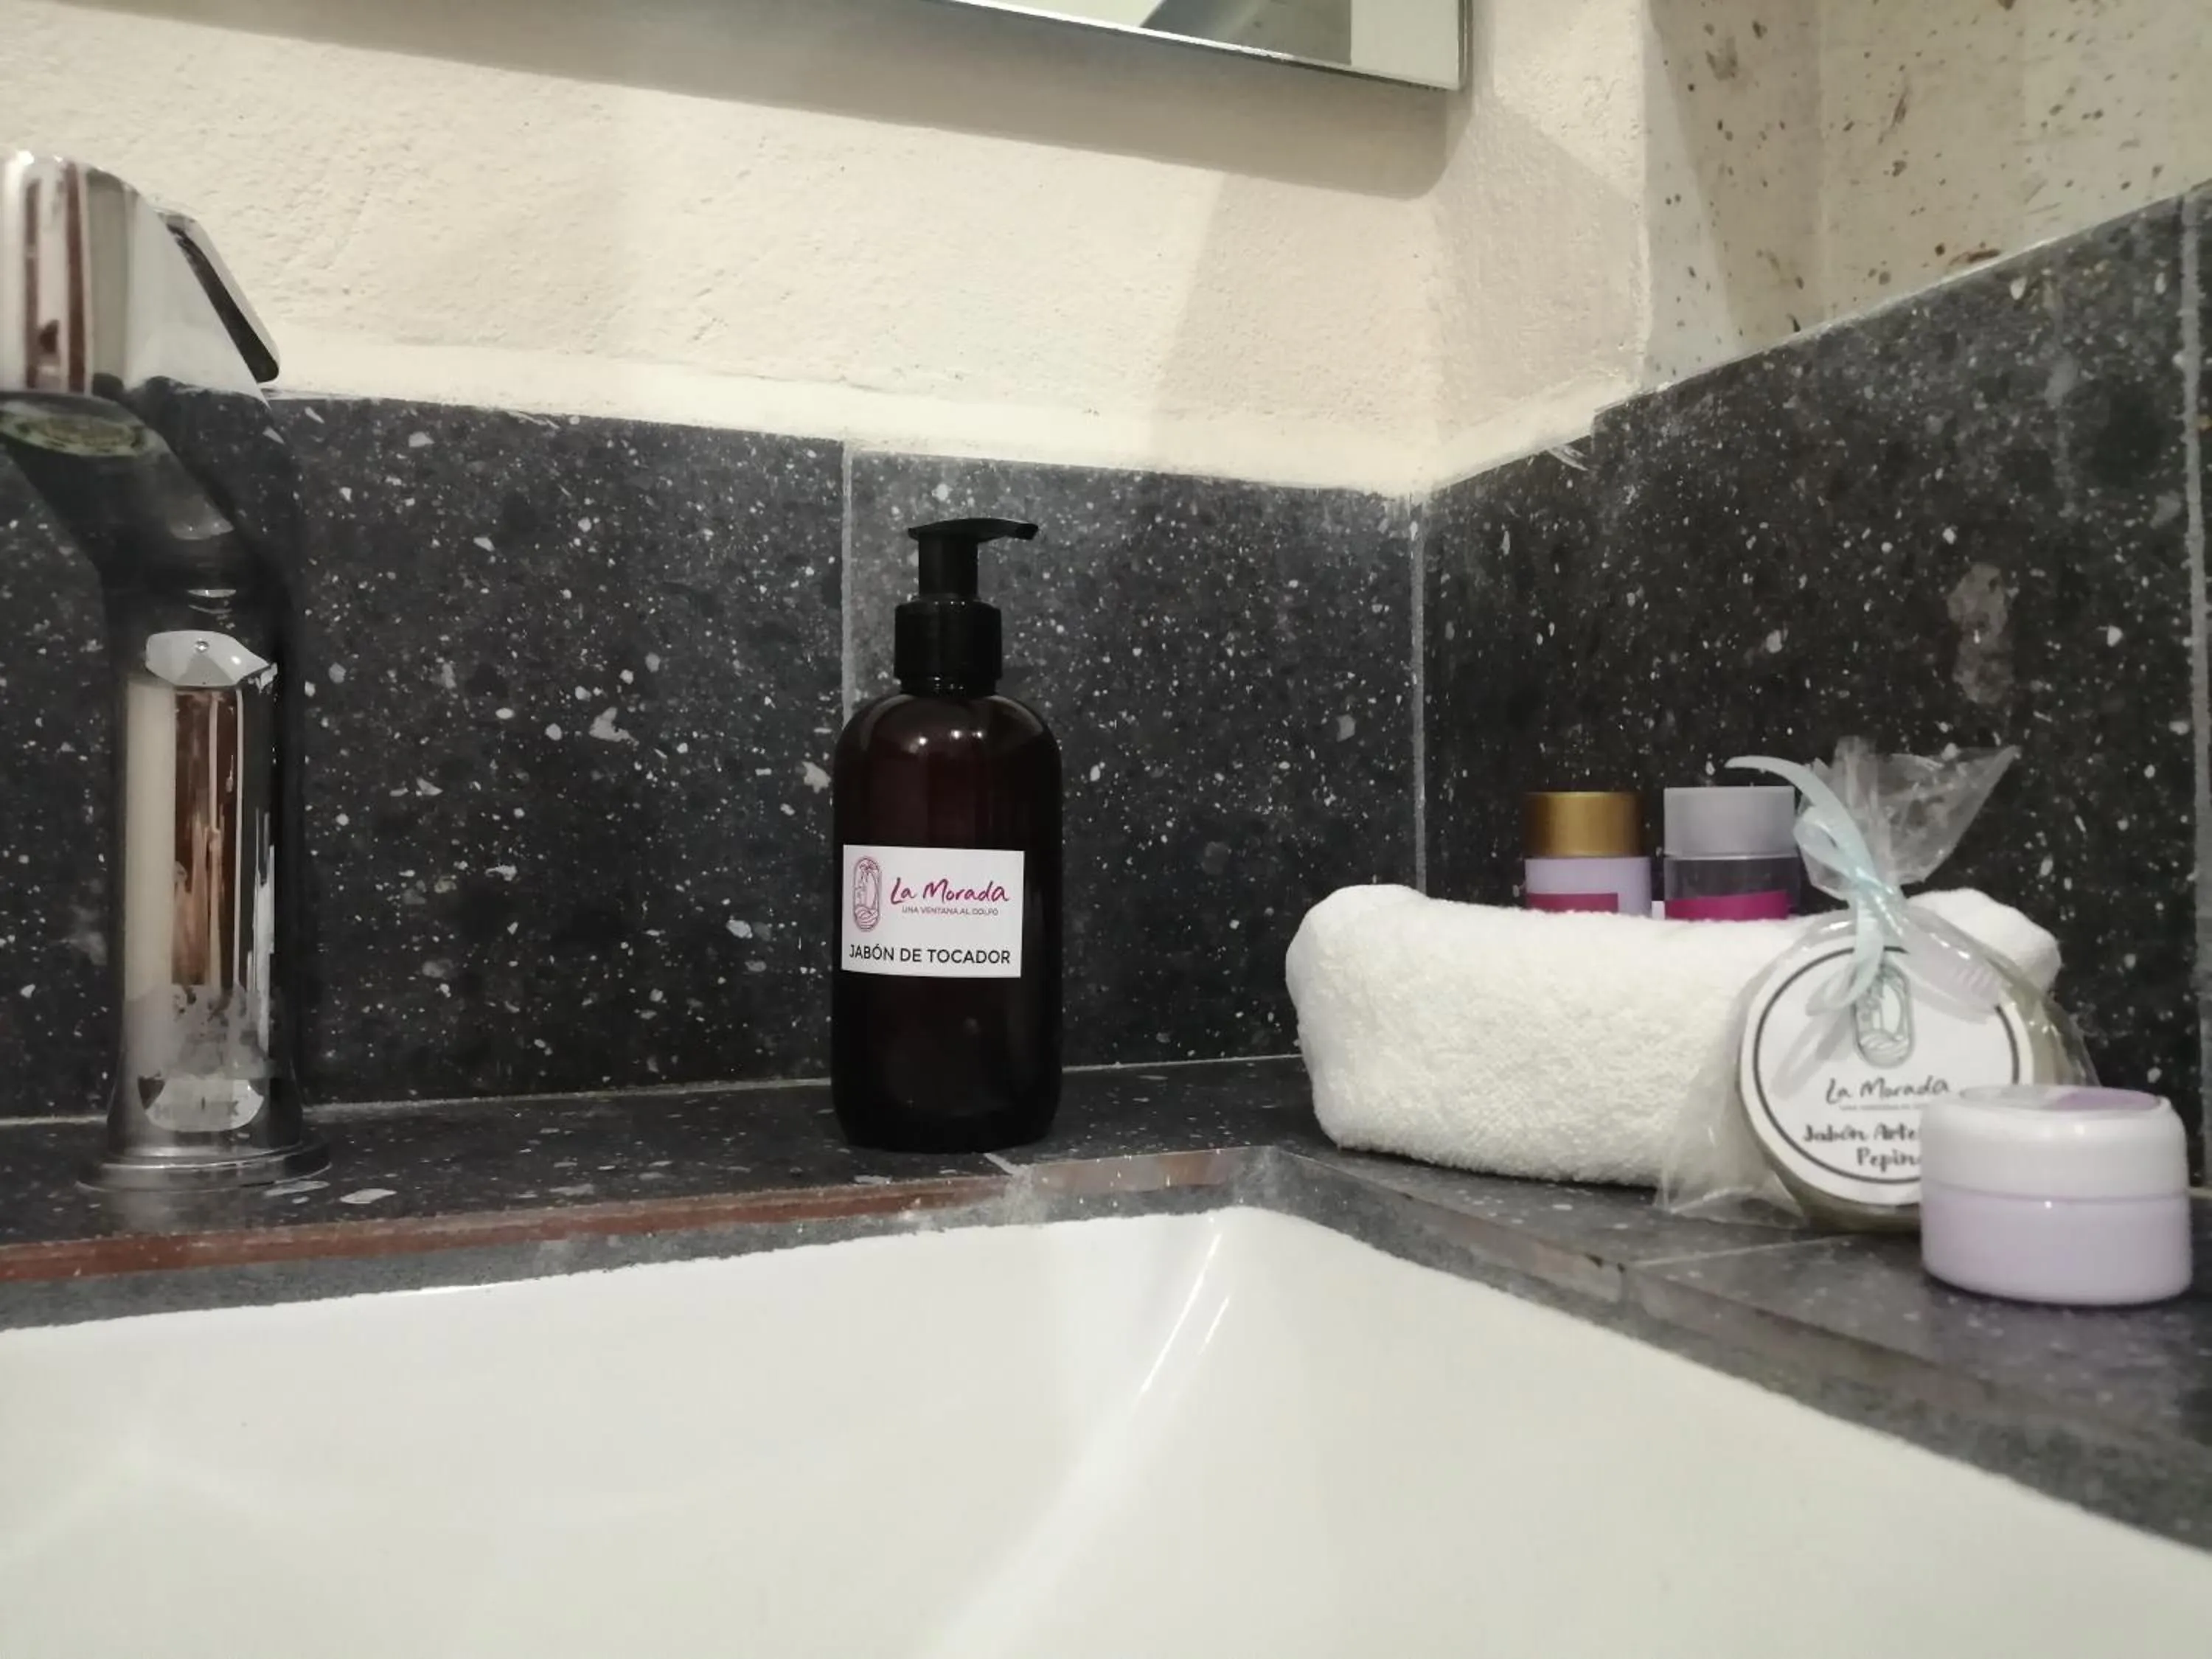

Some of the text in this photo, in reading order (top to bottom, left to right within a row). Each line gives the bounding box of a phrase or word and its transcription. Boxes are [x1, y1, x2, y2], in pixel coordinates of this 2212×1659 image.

[890, 877, 1009, 905] La Morada
[902, 905, 919, 914] UNA
[921, 906, 958, 915] VENTANA
[959, 907, 970, 915] AL
[849, 943, 1011, 964] JABÓN DE TOCADOR
[1826, 1075, 1951, 1105] La Morada
[1803, 1121, 1918, 1142] Jabón Arte
[1856, 1146, 1921, 1173] Pepin
